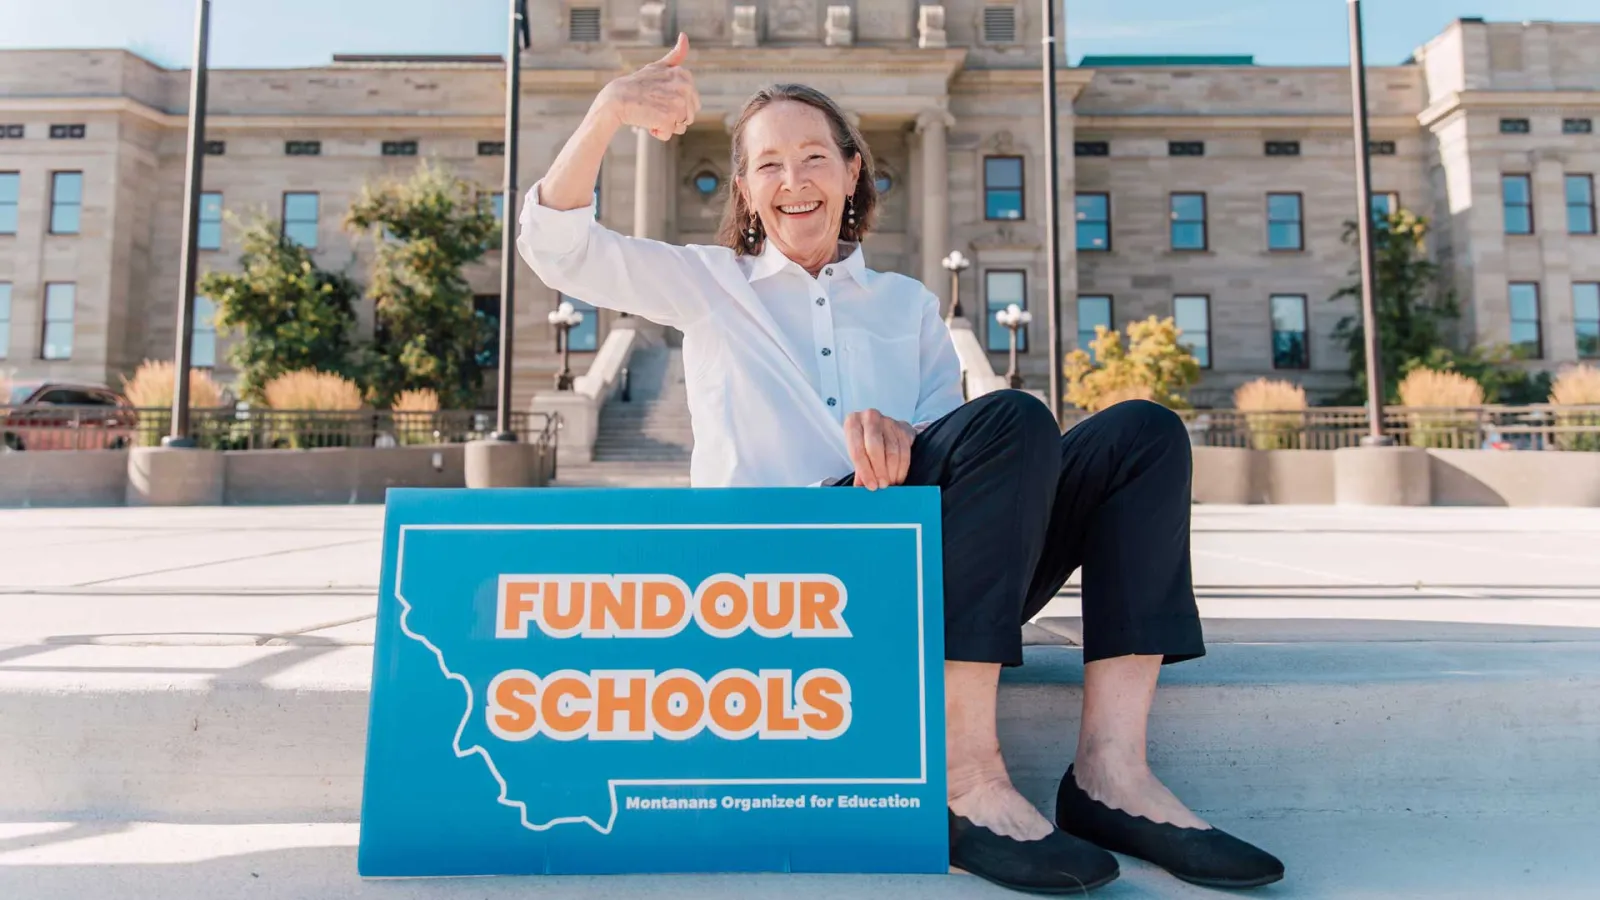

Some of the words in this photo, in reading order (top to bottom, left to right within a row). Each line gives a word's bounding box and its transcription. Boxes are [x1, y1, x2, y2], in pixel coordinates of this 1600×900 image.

[501, 579, 687, 633] FUND
[698, 578, 843, 633] OUR
[491, 673, 848, 735] SCHOOLS
[625, 796, 717, 810] Montanans
[721, 794, 806, 811] Organized
[810, 794, 834, 808] for
[837, 793, 921, 808] Education
